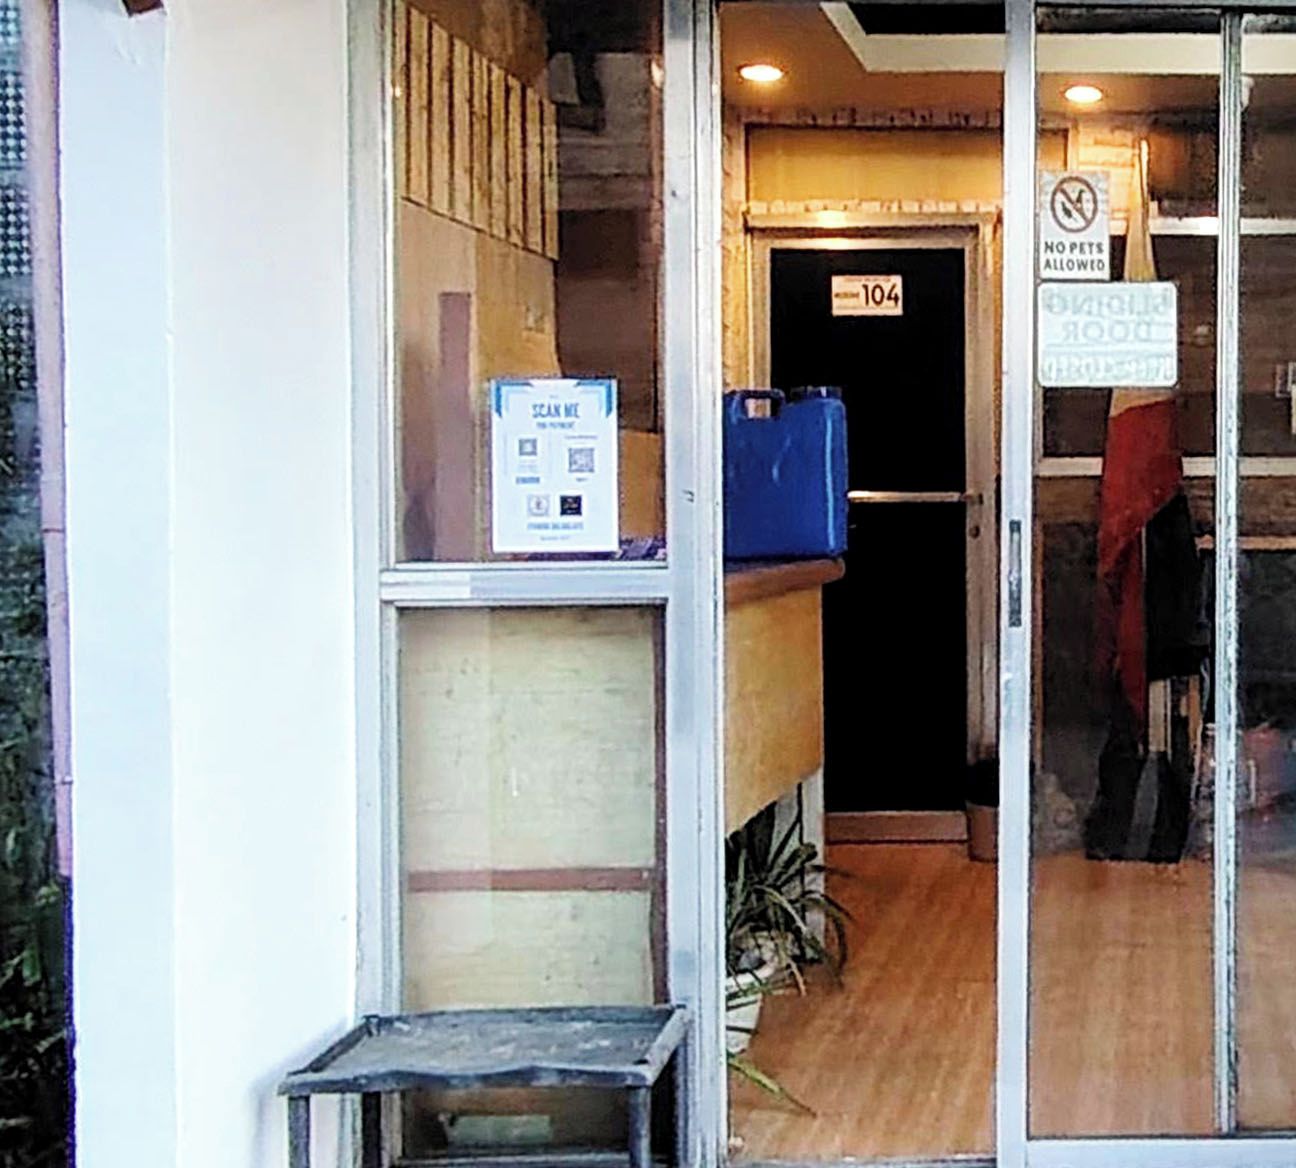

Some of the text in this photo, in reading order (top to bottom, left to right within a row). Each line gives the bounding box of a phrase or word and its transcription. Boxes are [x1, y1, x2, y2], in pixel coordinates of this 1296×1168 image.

[1044, 240, 1105, 255] NO PETS
[1044, 258, 1106, 272] ALLOWED
[861, 283, 900, 307] 104
[532, 403, 580, 418] SCAN ME
